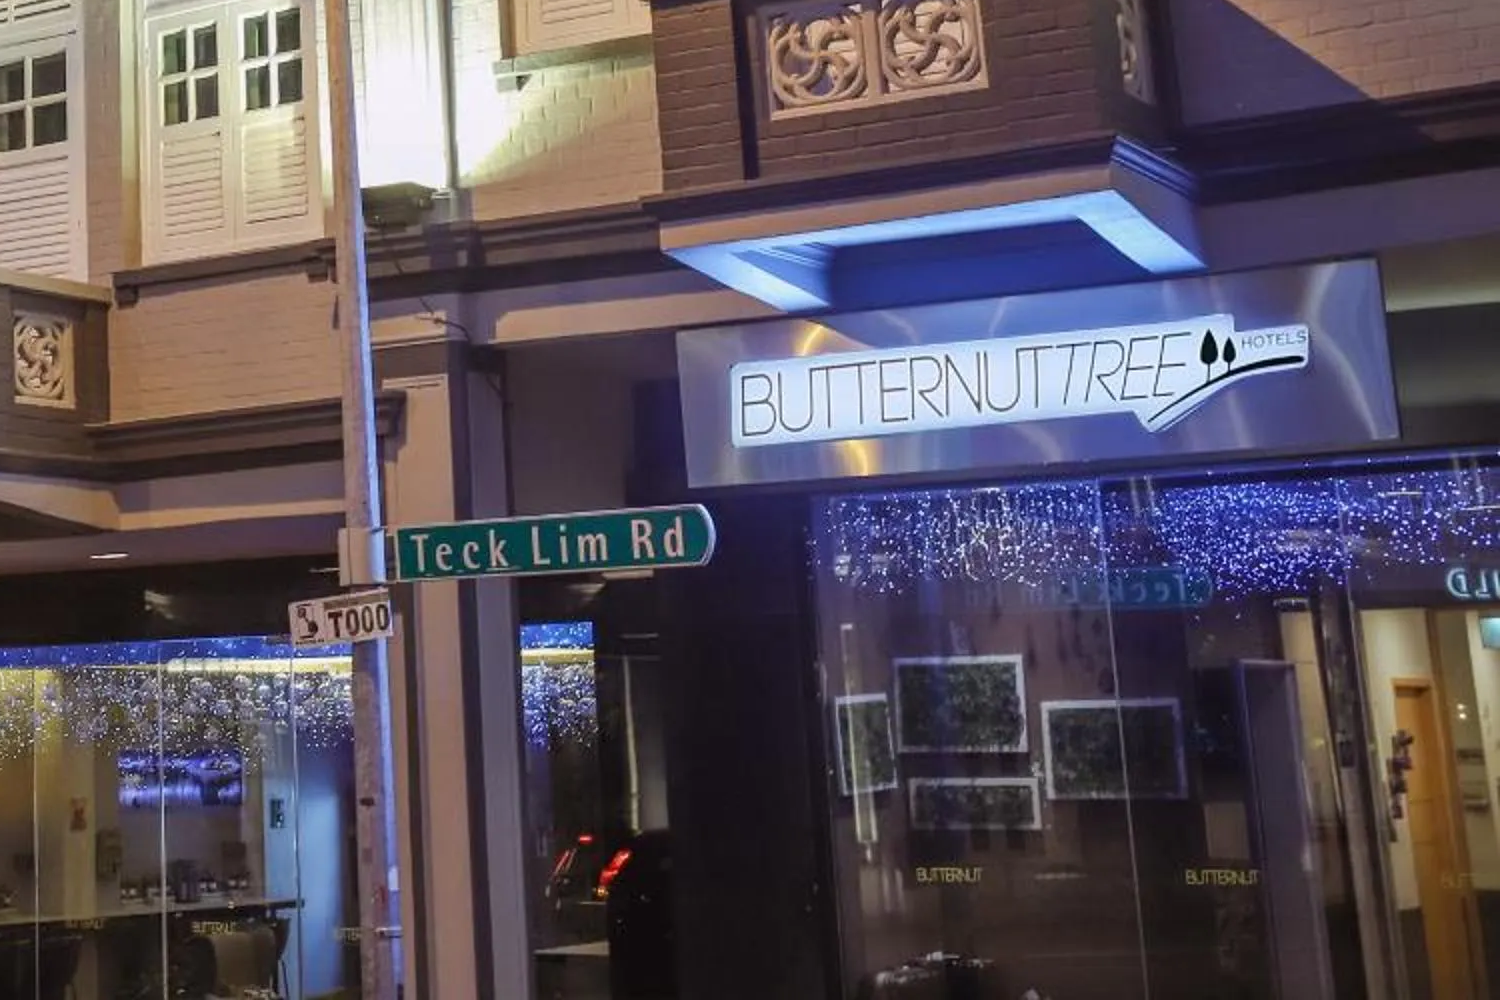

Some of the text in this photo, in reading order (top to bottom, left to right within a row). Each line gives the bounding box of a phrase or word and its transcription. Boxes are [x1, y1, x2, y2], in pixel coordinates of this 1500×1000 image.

[1241, 330, 1307, 349] HOTELS
[410, 516, 685, 572] Teck Lim Rd
[915, 866, 983, 883] BUTTERNUT
[1185, 869, 1260, 885] BUTTERNUT
